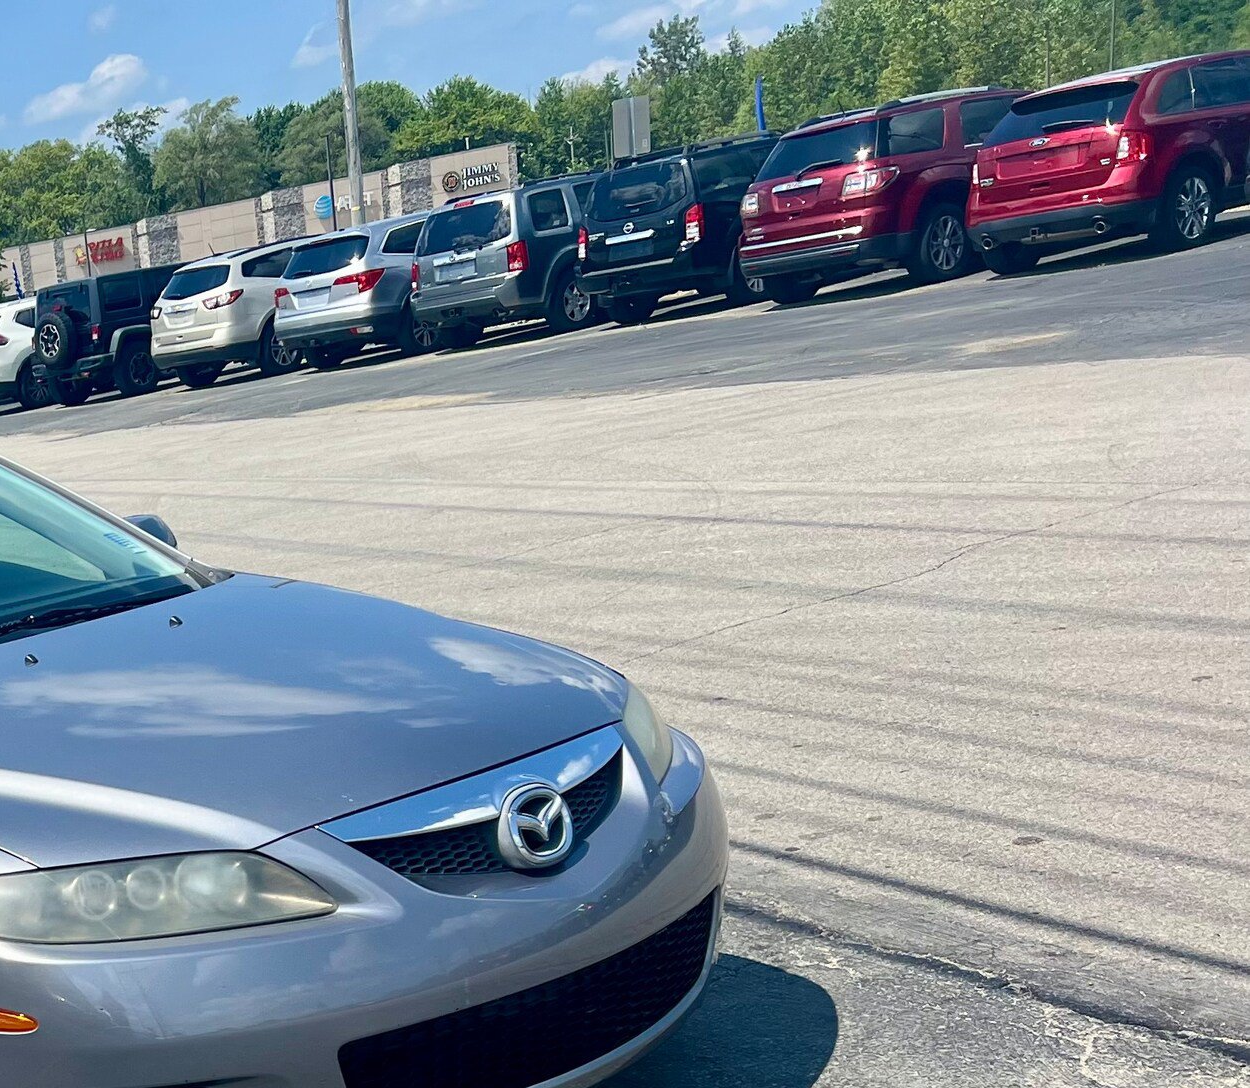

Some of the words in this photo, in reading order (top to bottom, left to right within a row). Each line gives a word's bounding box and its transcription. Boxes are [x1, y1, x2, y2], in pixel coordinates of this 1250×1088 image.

[462, 162, 499, 179] JIMMY
[462, 172, 501, 191] JOHN'S
[87, 236, 124, 255] PIZZA
